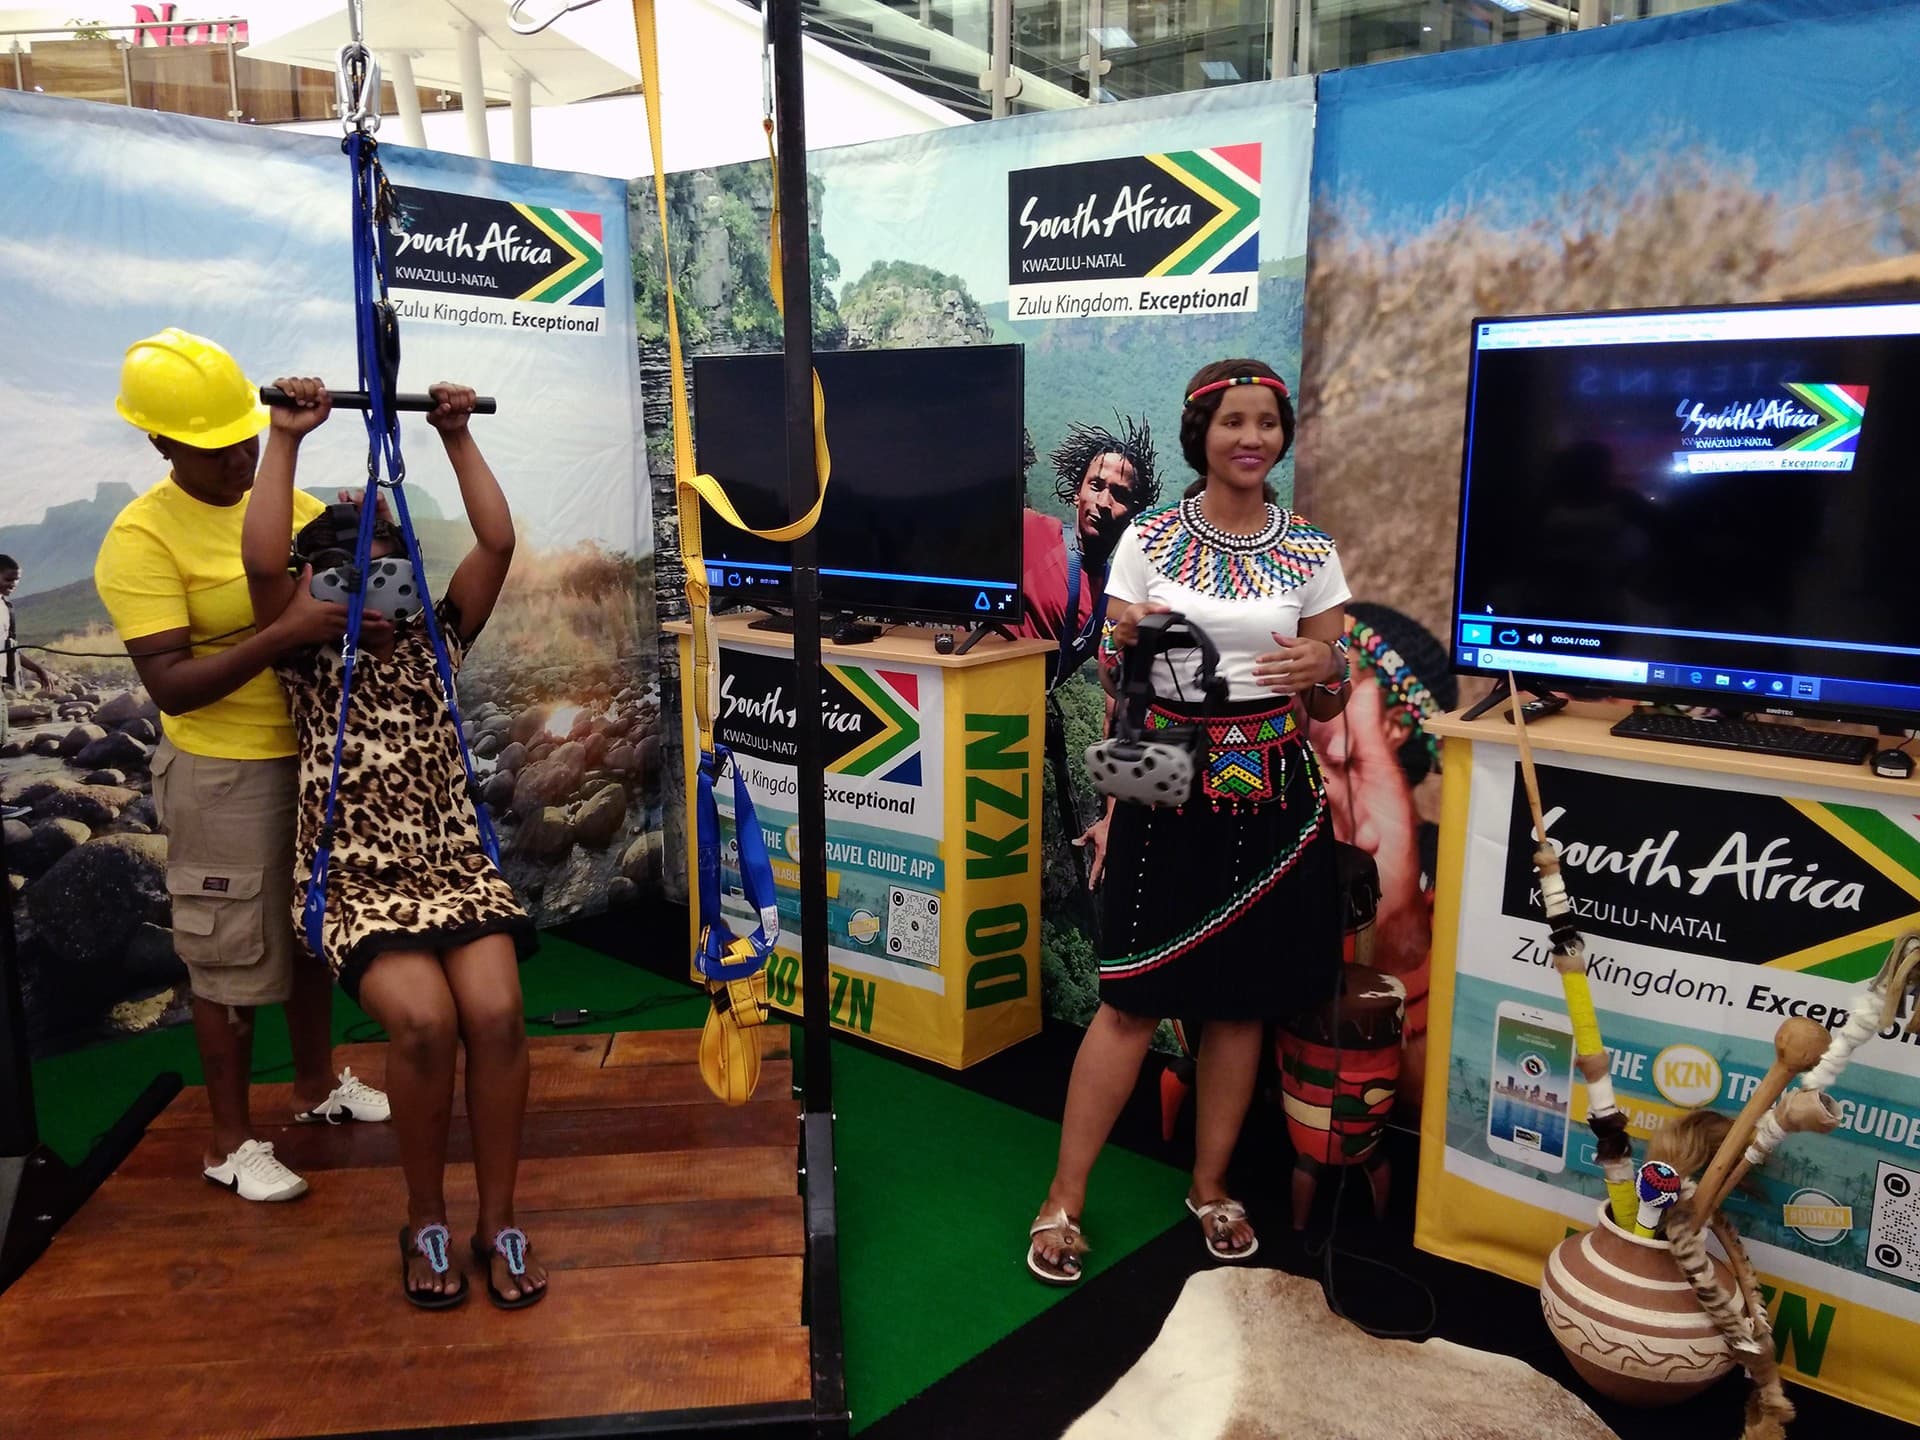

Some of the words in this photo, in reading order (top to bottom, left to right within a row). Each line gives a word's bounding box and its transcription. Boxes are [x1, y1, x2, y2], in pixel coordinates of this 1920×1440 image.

[1019, 193, 1100, 250] South
[1102, 183, 1192, 238] Africa
[475, 222, 552, 265] Africa
[1022, 253, 1126, 274] KWAZULU-NATAL
[395, 266, 499, 289] KWAZULU-NATAL
[393, 299, 429, 319] Zulu
[433, 303, 508, 326] Kingdom.
[512, 311, 600, 333] Exceptional
[1017, 295, 1051, 316] Zulu
[1055, 294, 1133, 318] Kingdom.
[1138, 286, 1250, 314] Exceptional
[1690, 403, 1755, 436] South
[1755, 400, 1820, 431] Africa
[1695, 437, 1774, 449] KWAZULU-NATAL
[1780, 458, 1848, 471] Exceptional
[721, 674, 784, 725] South
[752, 769, 797, 795] Kingdo
[964, 713, 1029, 880] KZN
[761, 828, 783, 850] THE
[825, 842, 864, 866] RAVEL
[868, 849, 907, 875] GUIDE
[909, 858, 936, 880] APP
[1531, 806, 1682, 889] South
[1687, 831, 1865, 912] Africa
[1529, 887, 1727, 943] KAZULU-NATAL
[965, 903, 1029, 1010] DO
[1585, 953, 1734, 1007] Kingdom.
[830, 971, 876, 1035] ZN
[1664, 1061, 1713, 1089] KZN
